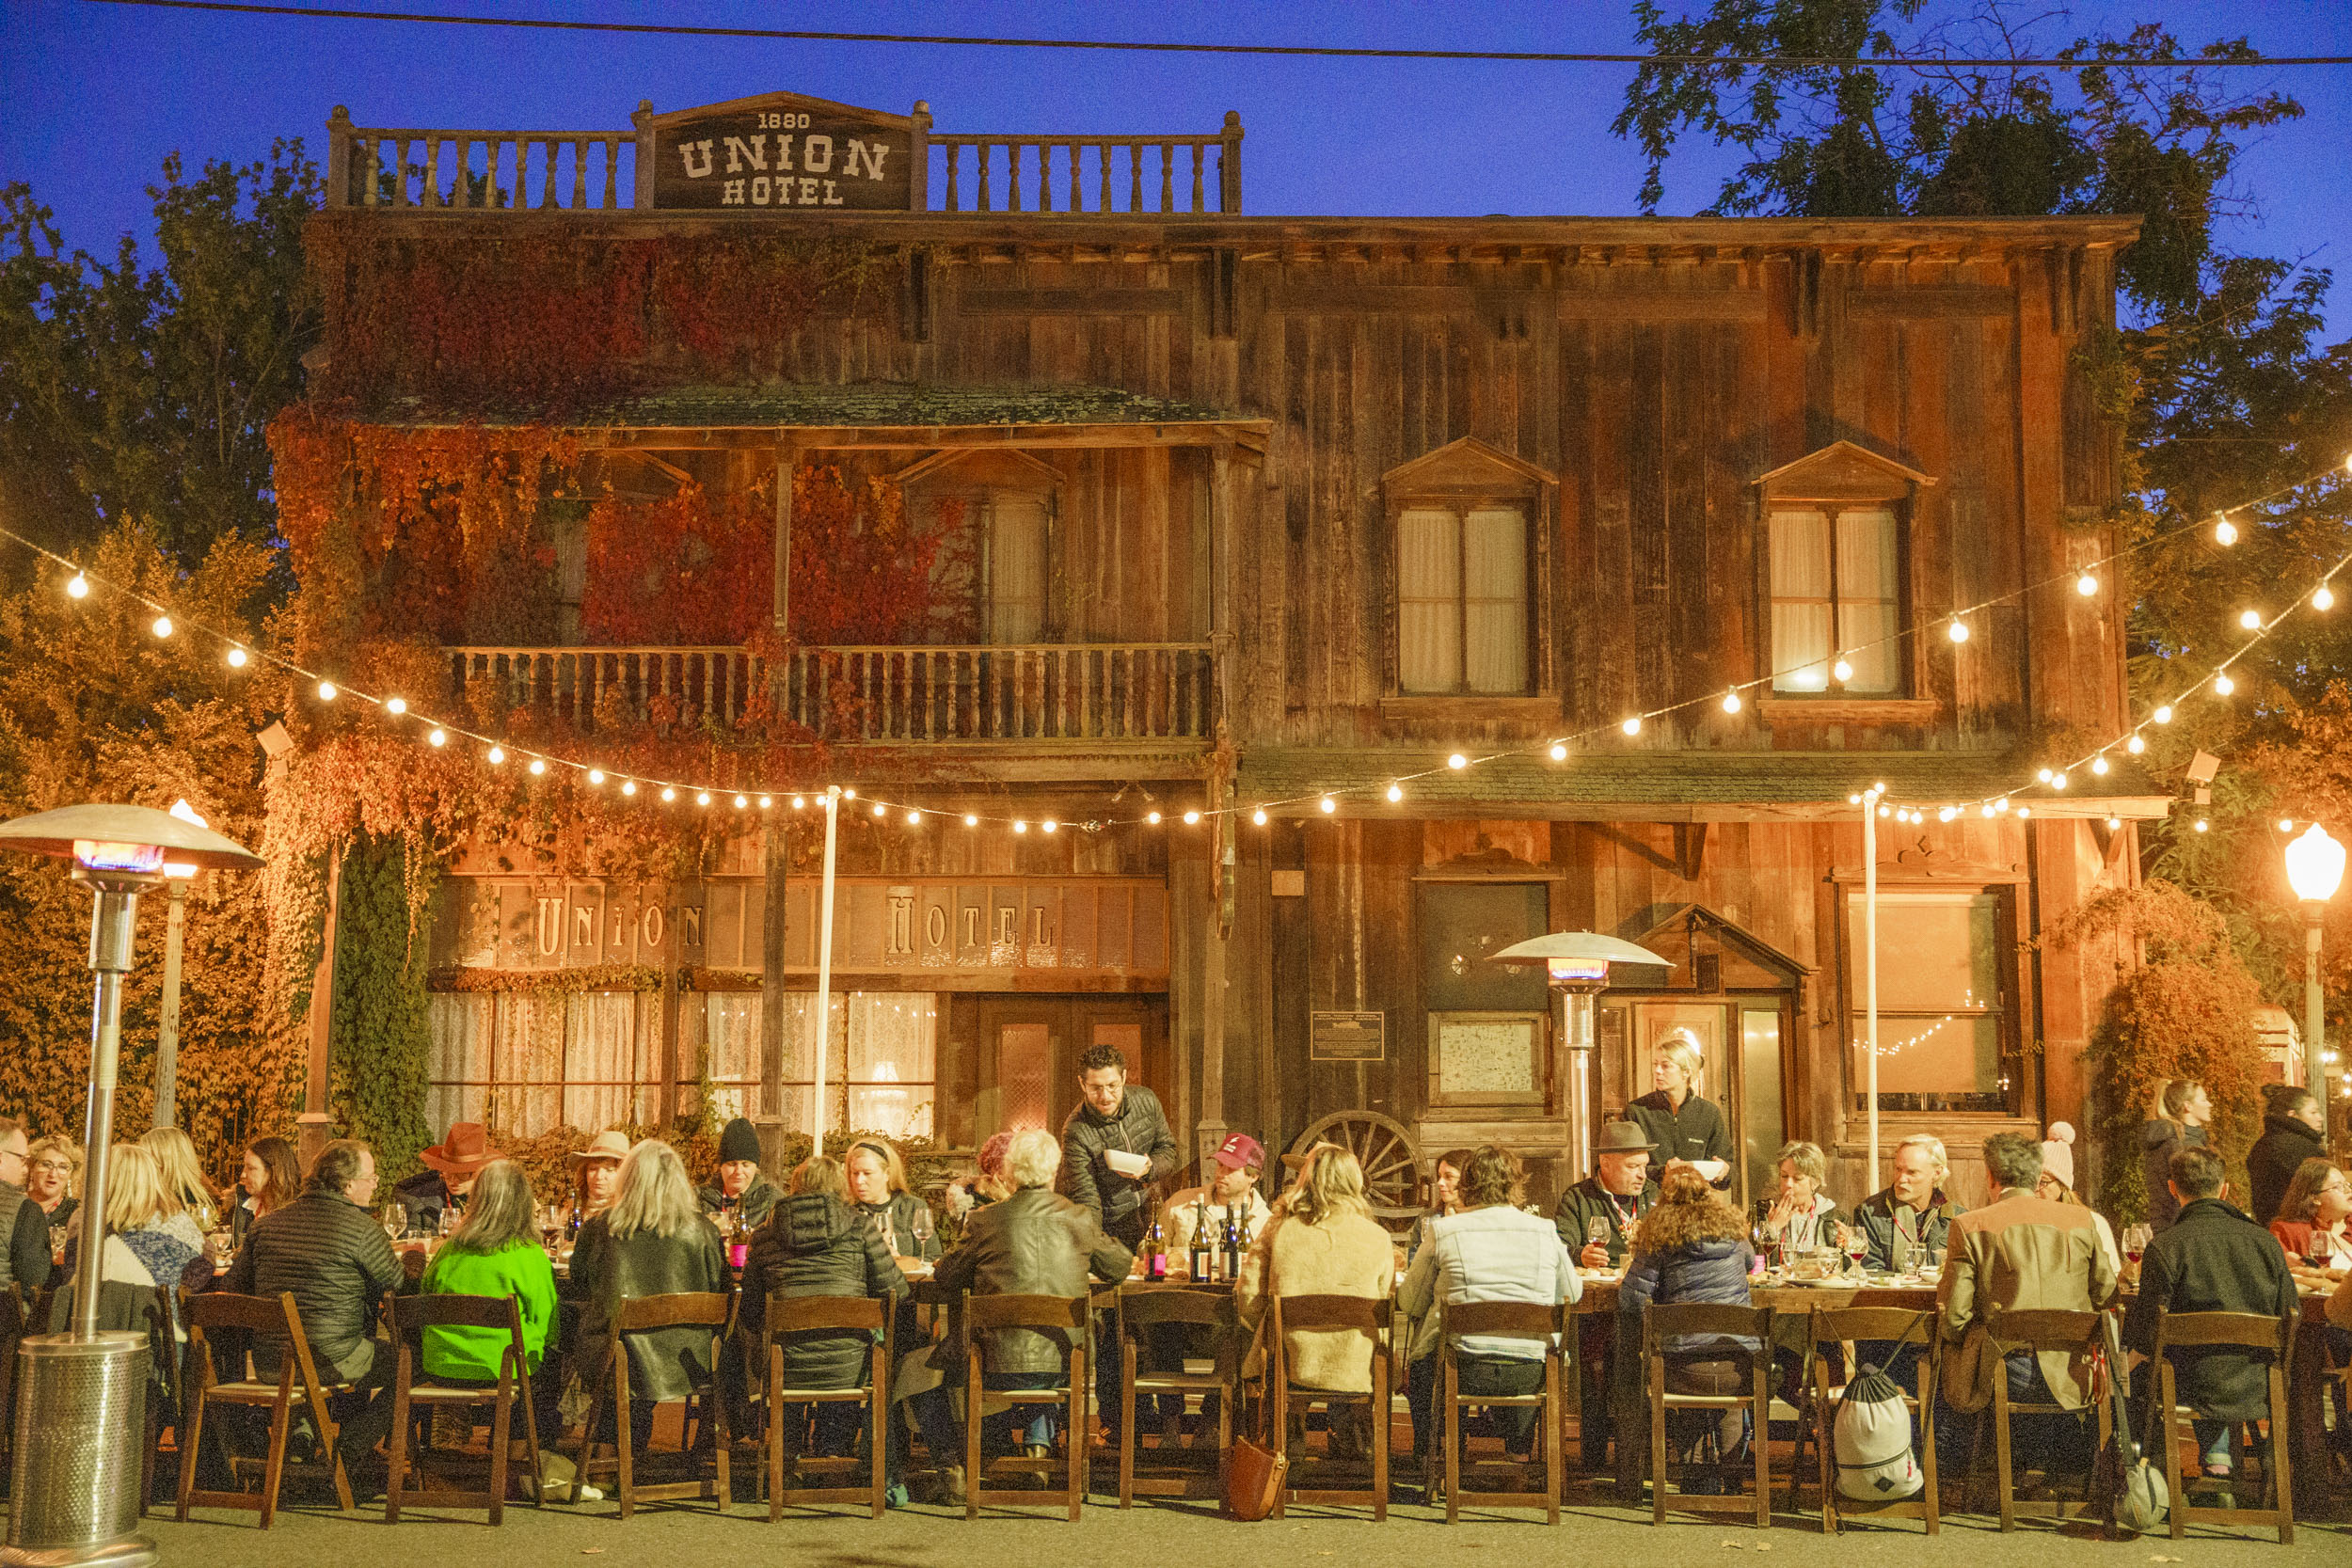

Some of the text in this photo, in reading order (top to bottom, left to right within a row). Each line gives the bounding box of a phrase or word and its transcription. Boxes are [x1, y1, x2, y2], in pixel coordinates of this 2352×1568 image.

[758, 113, 810, 129] 1880
[678, 134, 890, 182] UNION
[722, 176, 843, 205] HOTEL
[888, 896, 1053, 955] HOTEL
